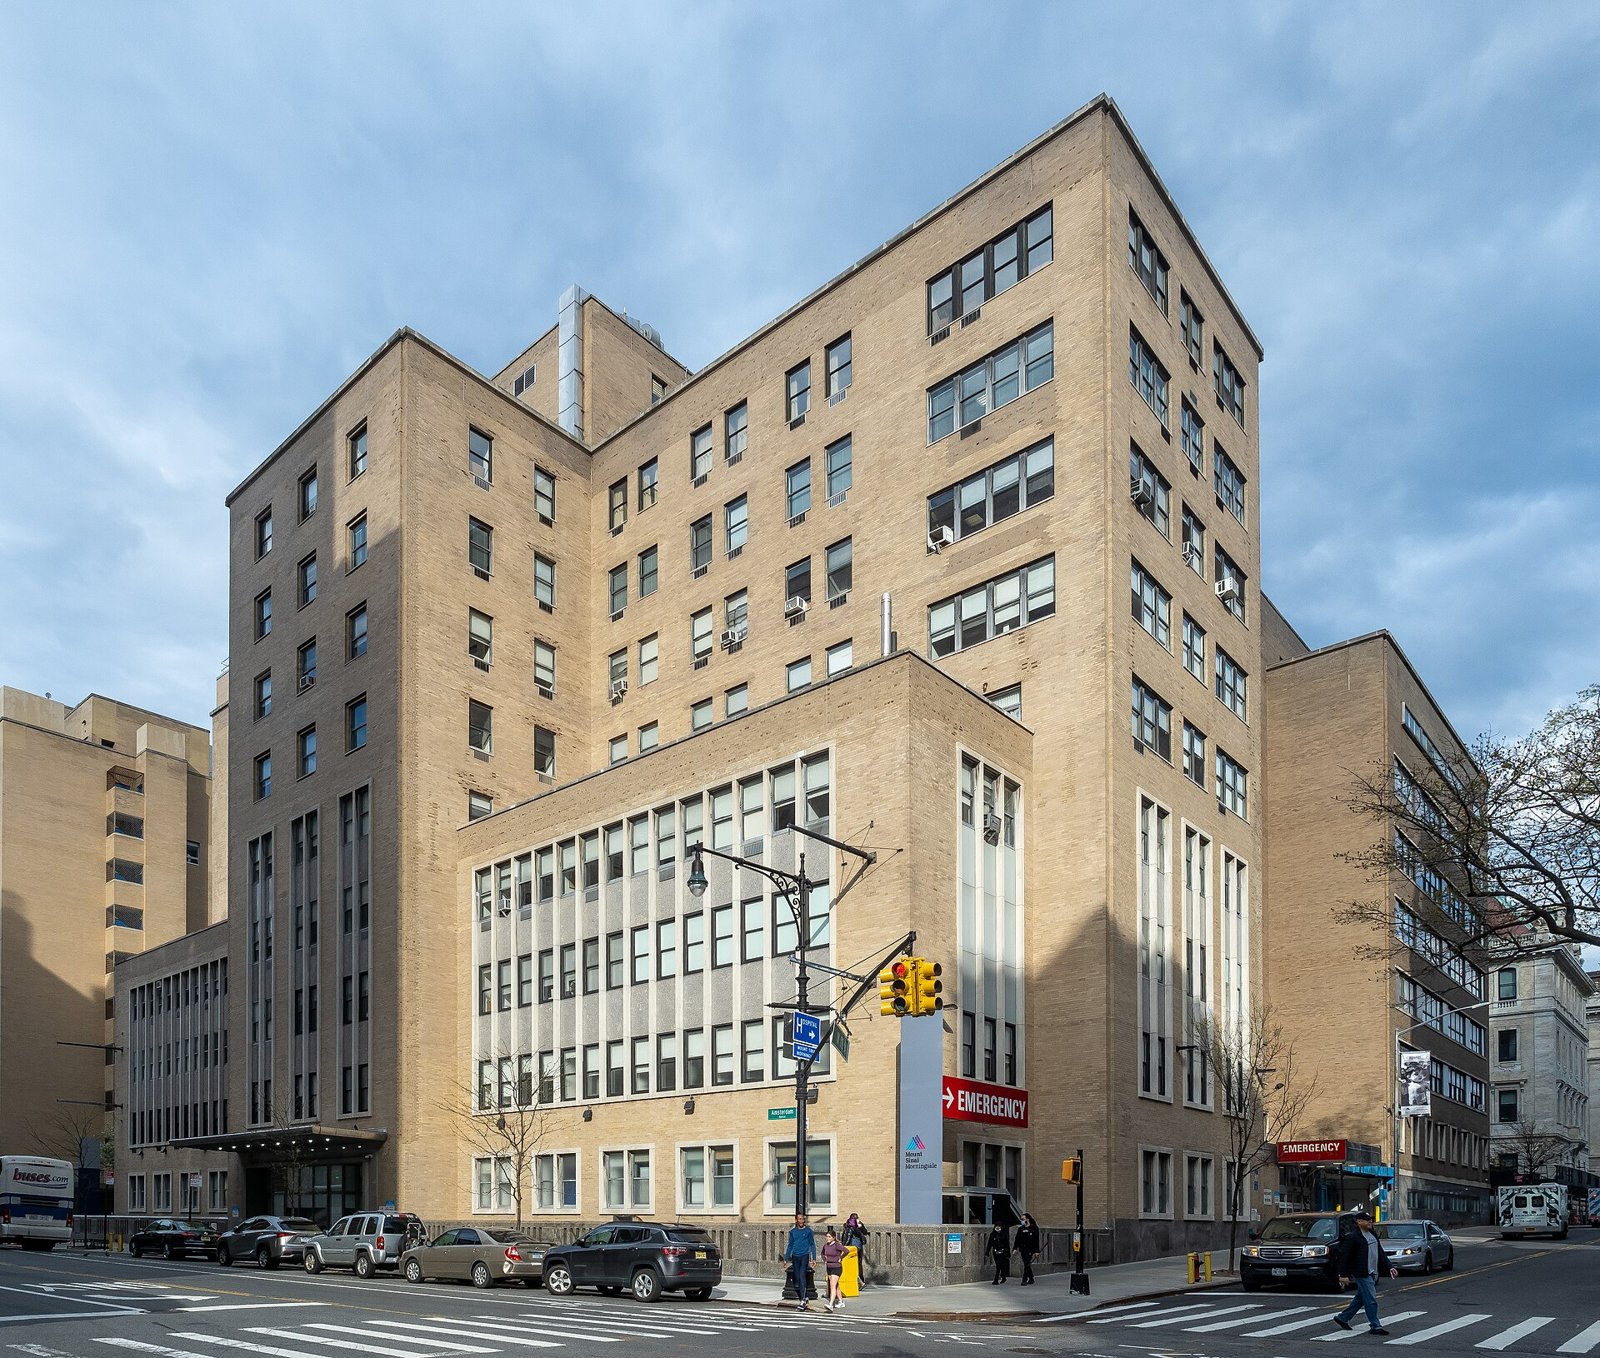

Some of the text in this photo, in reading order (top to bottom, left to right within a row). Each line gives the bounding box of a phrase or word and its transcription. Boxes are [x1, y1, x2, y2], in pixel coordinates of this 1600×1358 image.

[796, 1016, 818, 1034] HOSPITAL
[957, 1089, 1026, 1120] EMERGENCY
[1283, 1142, 1341, 1154] EMERGENCY
[13, 1167, 69, 1183] buses.com
